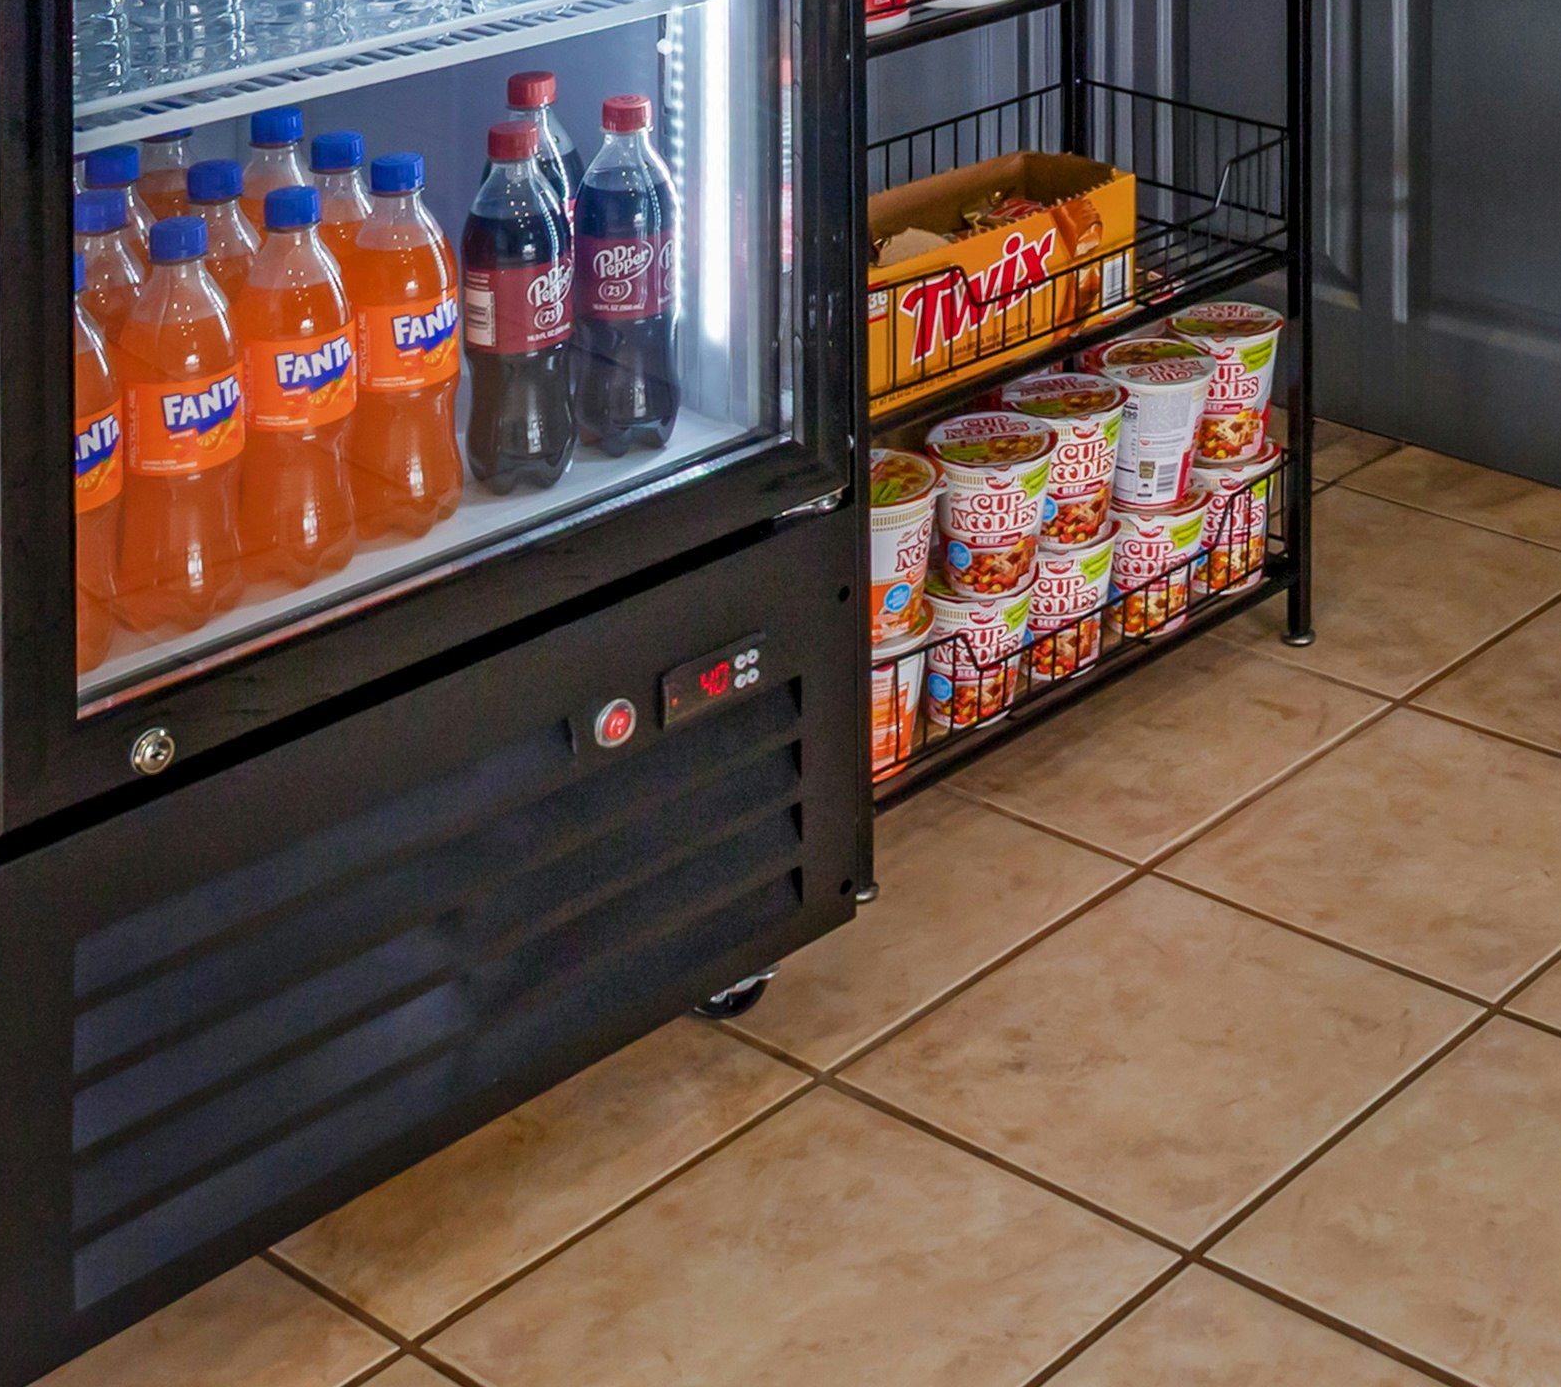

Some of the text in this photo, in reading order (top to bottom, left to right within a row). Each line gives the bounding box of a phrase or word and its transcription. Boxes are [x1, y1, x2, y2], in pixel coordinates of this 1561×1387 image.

[599, 248, 650, 279] Pepper
[614, 245, 637, 264] Dr
[606, 285, 621, 296] 23
[899, 227, 1057, 365] Twix
[392, 297, 459, 346] FANTA
[276, 334, 352, 385] FANTA
[162, 374, 241, 431] FANTA
[1058, 439, 1108, 464] CUP
[971, 491, 1026, 514] CUP
[951, 501, 1038, 533] NOODLES
[1123, 540, 1173, 561] CUP
[1035, 576, 1086, 600] CUP
